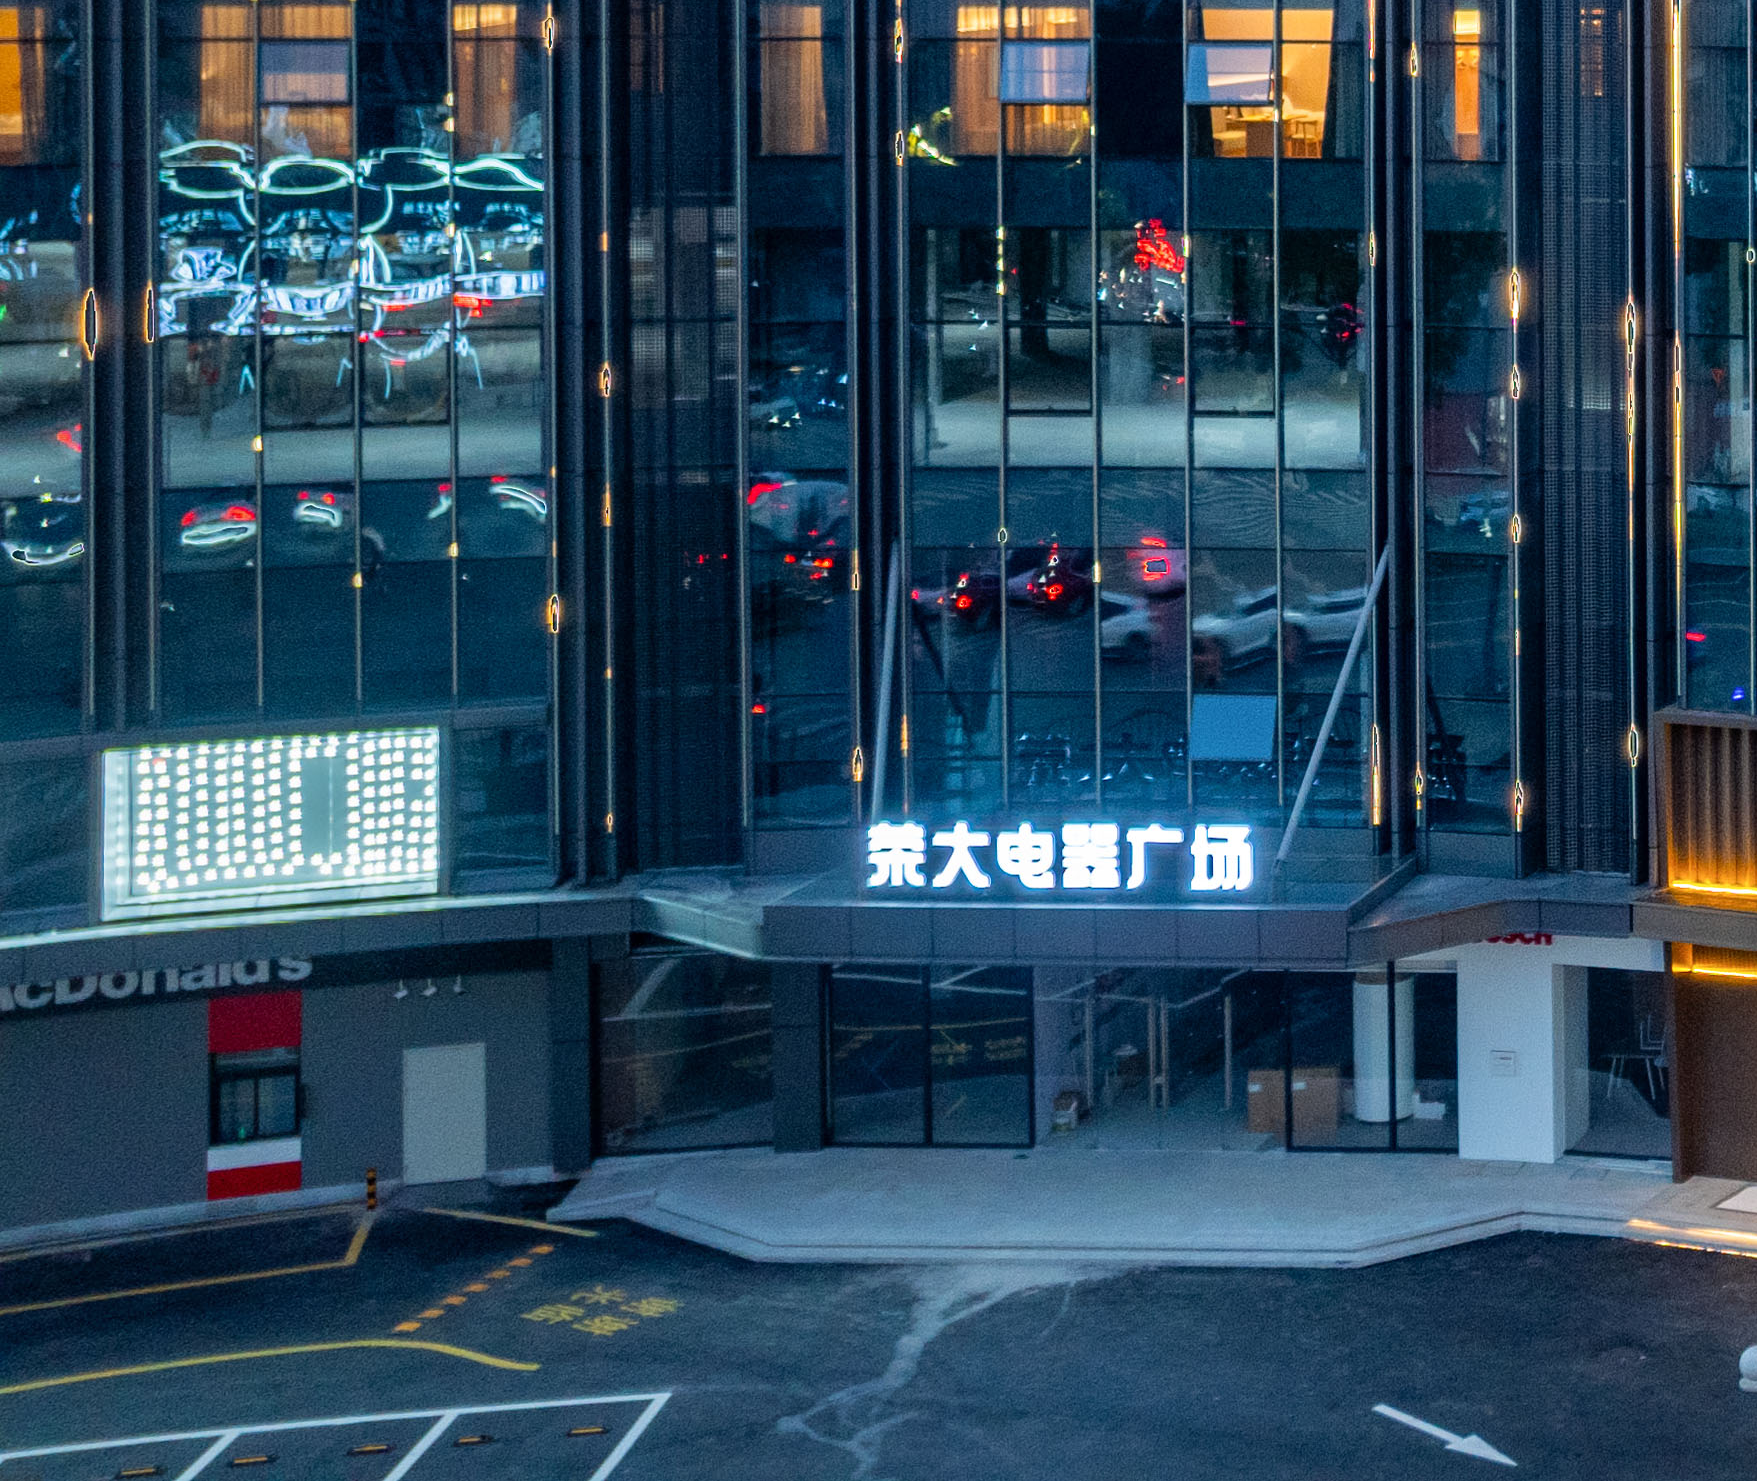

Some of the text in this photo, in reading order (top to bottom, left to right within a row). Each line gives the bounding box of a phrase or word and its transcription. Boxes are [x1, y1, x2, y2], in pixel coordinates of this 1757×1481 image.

[866, 820, 1254, 891] 荣大电器广场
